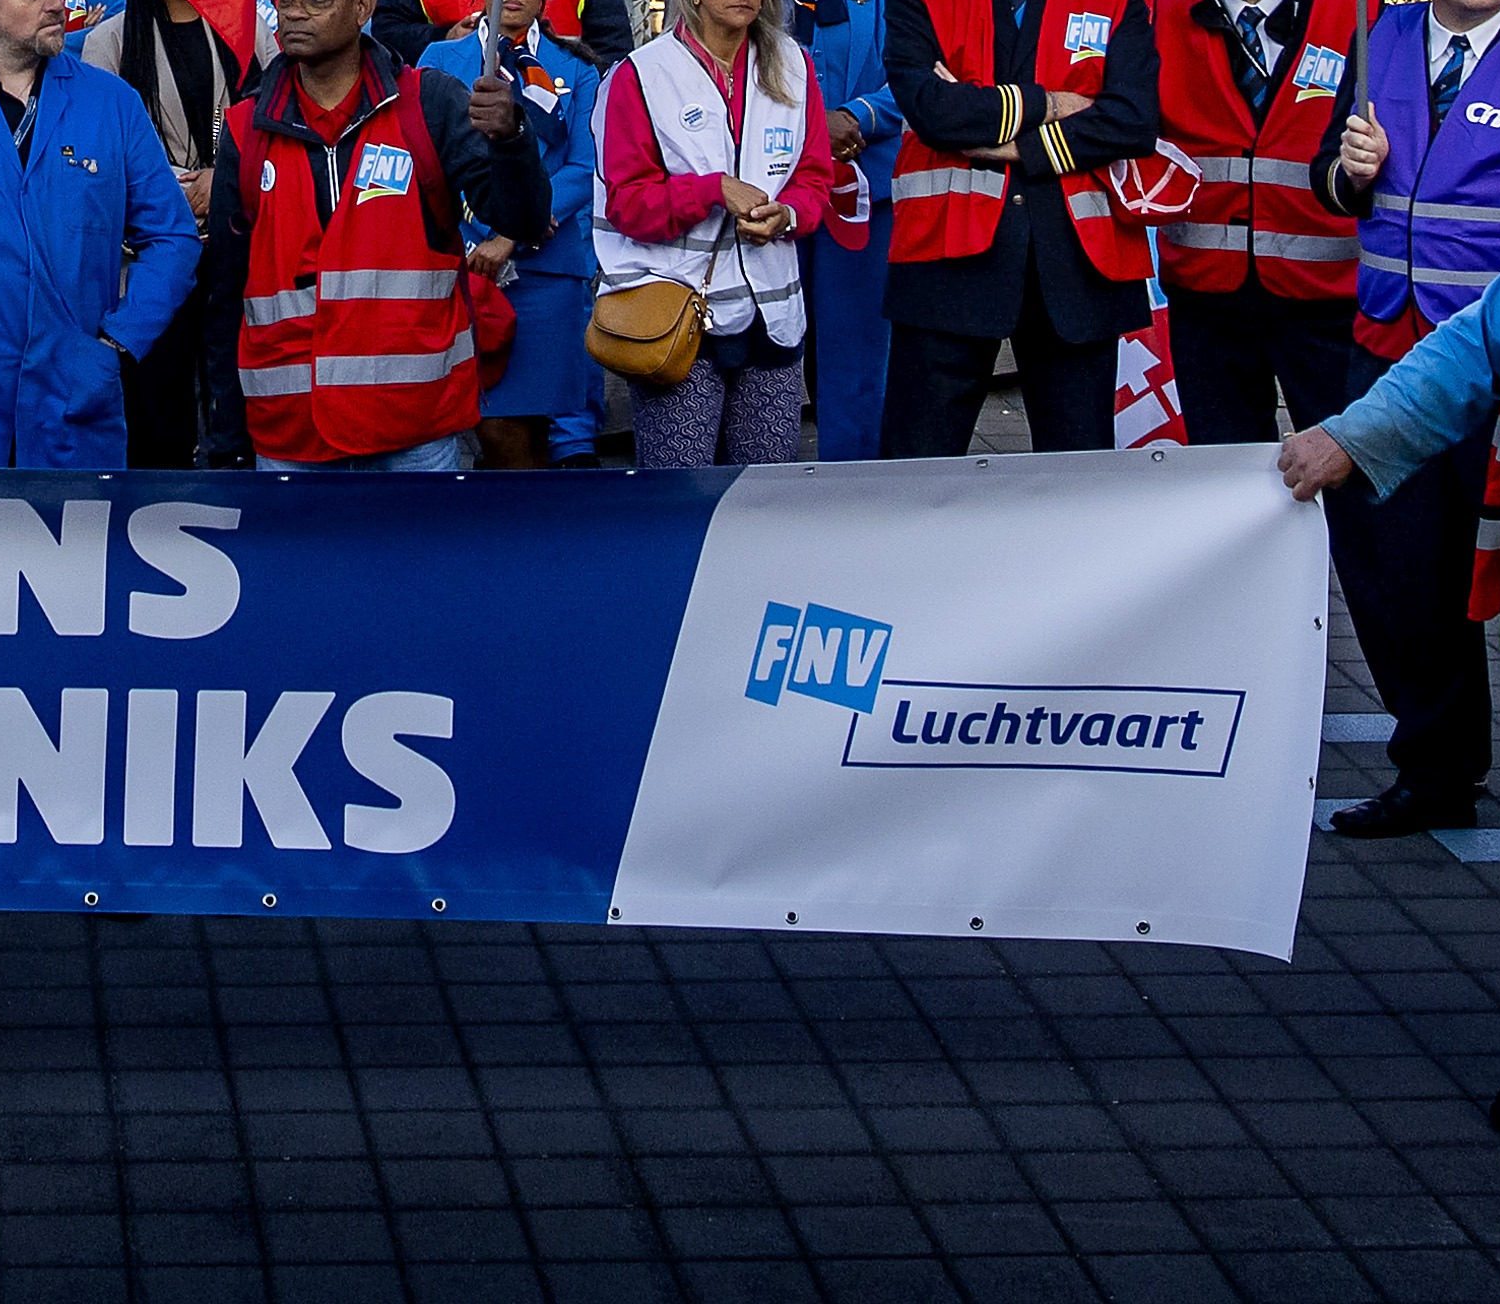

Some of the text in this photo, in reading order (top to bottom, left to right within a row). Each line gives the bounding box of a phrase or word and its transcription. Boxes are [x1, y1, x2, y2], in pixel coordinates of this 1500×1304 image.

[356, 147, 411, 189] FNV
[754, 624, 890, 688] FNV
[890, 700, 1204, 752] Luchtvaart
